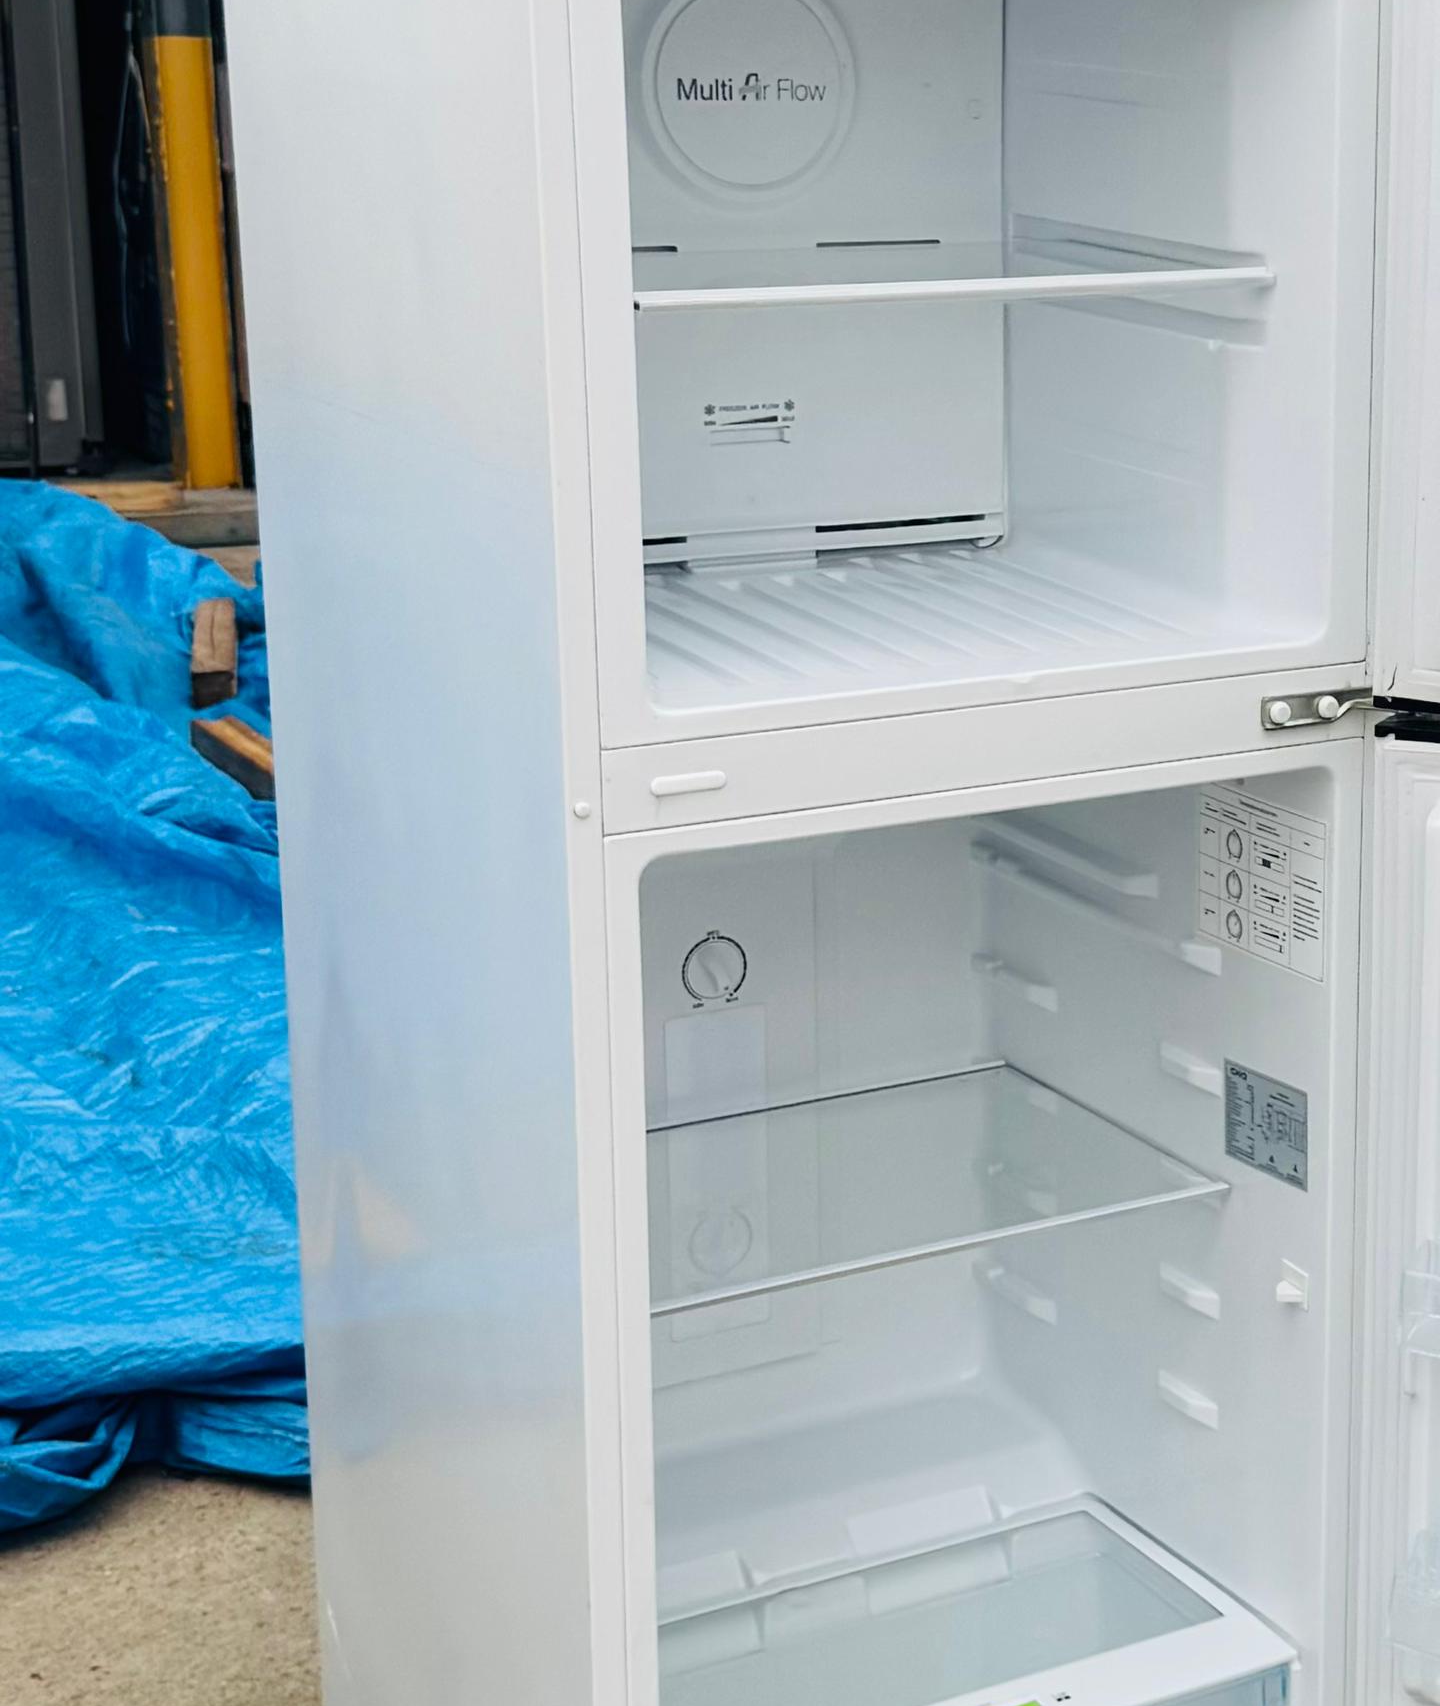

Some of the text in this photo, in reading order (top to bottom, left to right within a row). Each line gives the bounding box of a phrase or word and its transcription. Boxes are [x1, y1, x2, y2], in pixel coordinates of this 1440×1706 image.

[676, 73, 826, 101] Multi Air Flow
